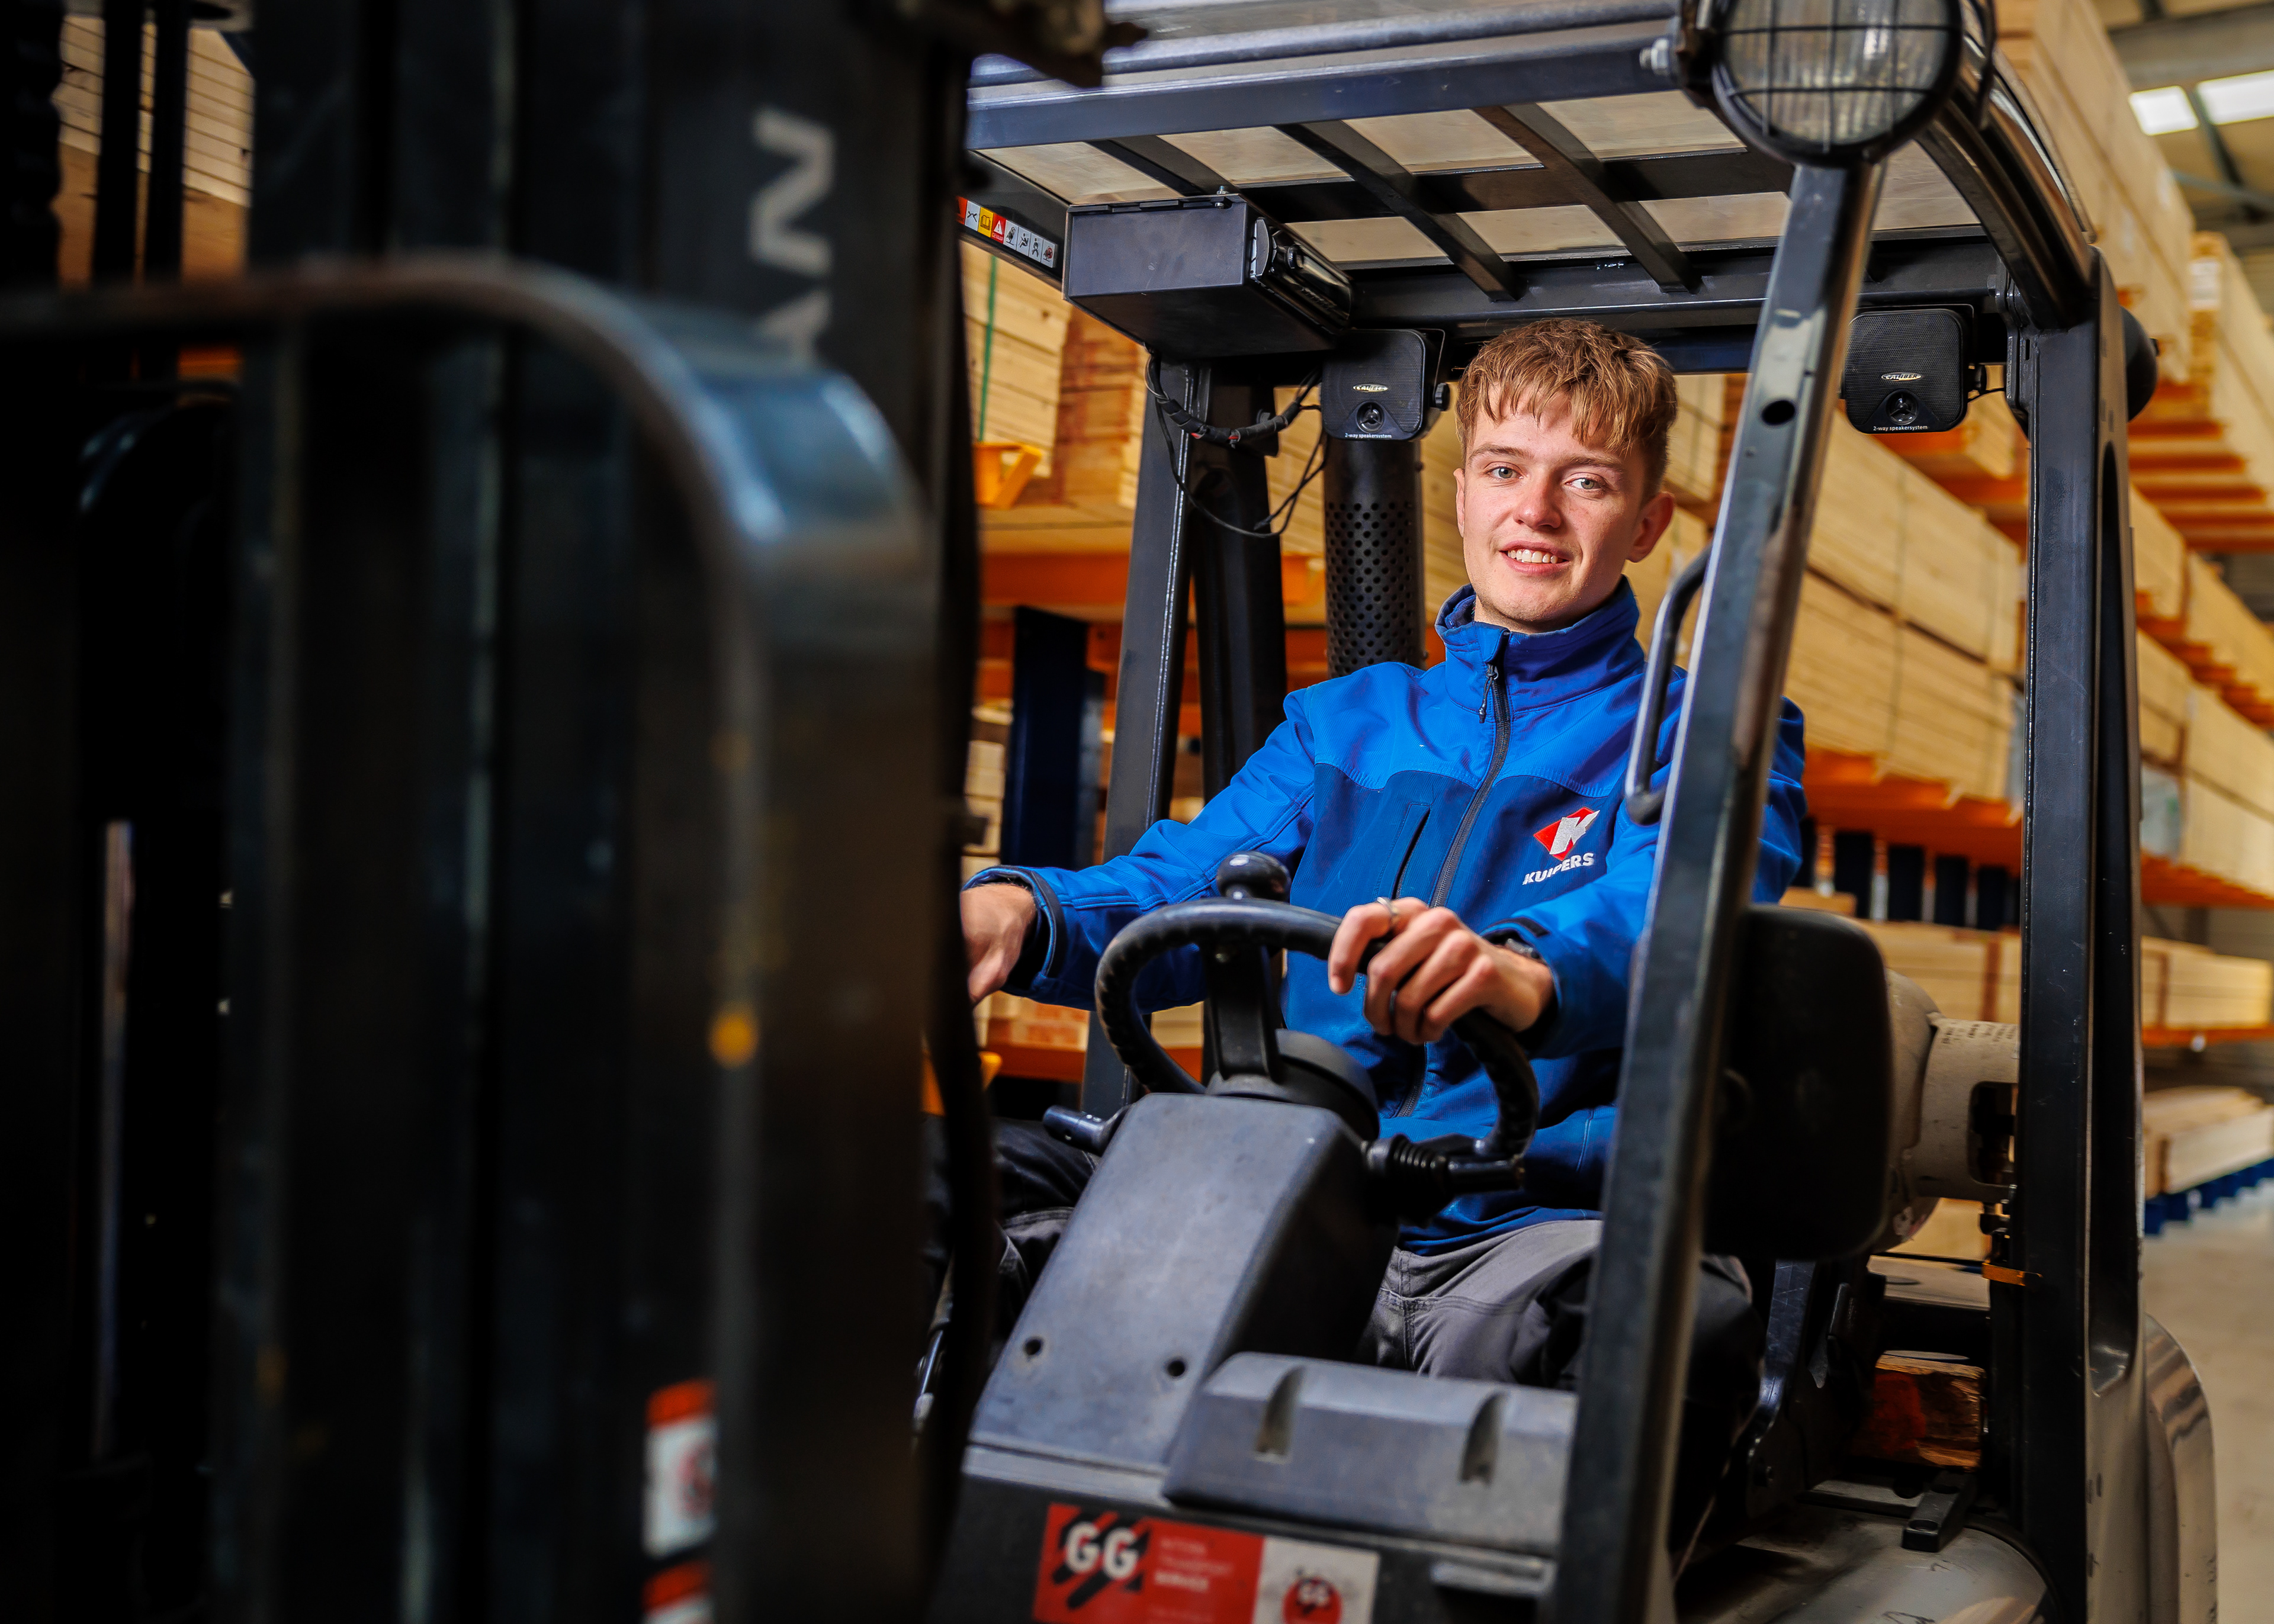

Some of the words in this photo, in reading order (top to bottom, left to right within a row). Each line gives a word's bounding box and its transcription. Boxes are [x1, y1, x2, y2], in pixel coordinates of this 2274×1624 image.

[1883, 372, 1920, 381] CALIBER
[1522, 853, 1594, 885] KUIPERS
[1065, 1520, 1140, 1581] GG
